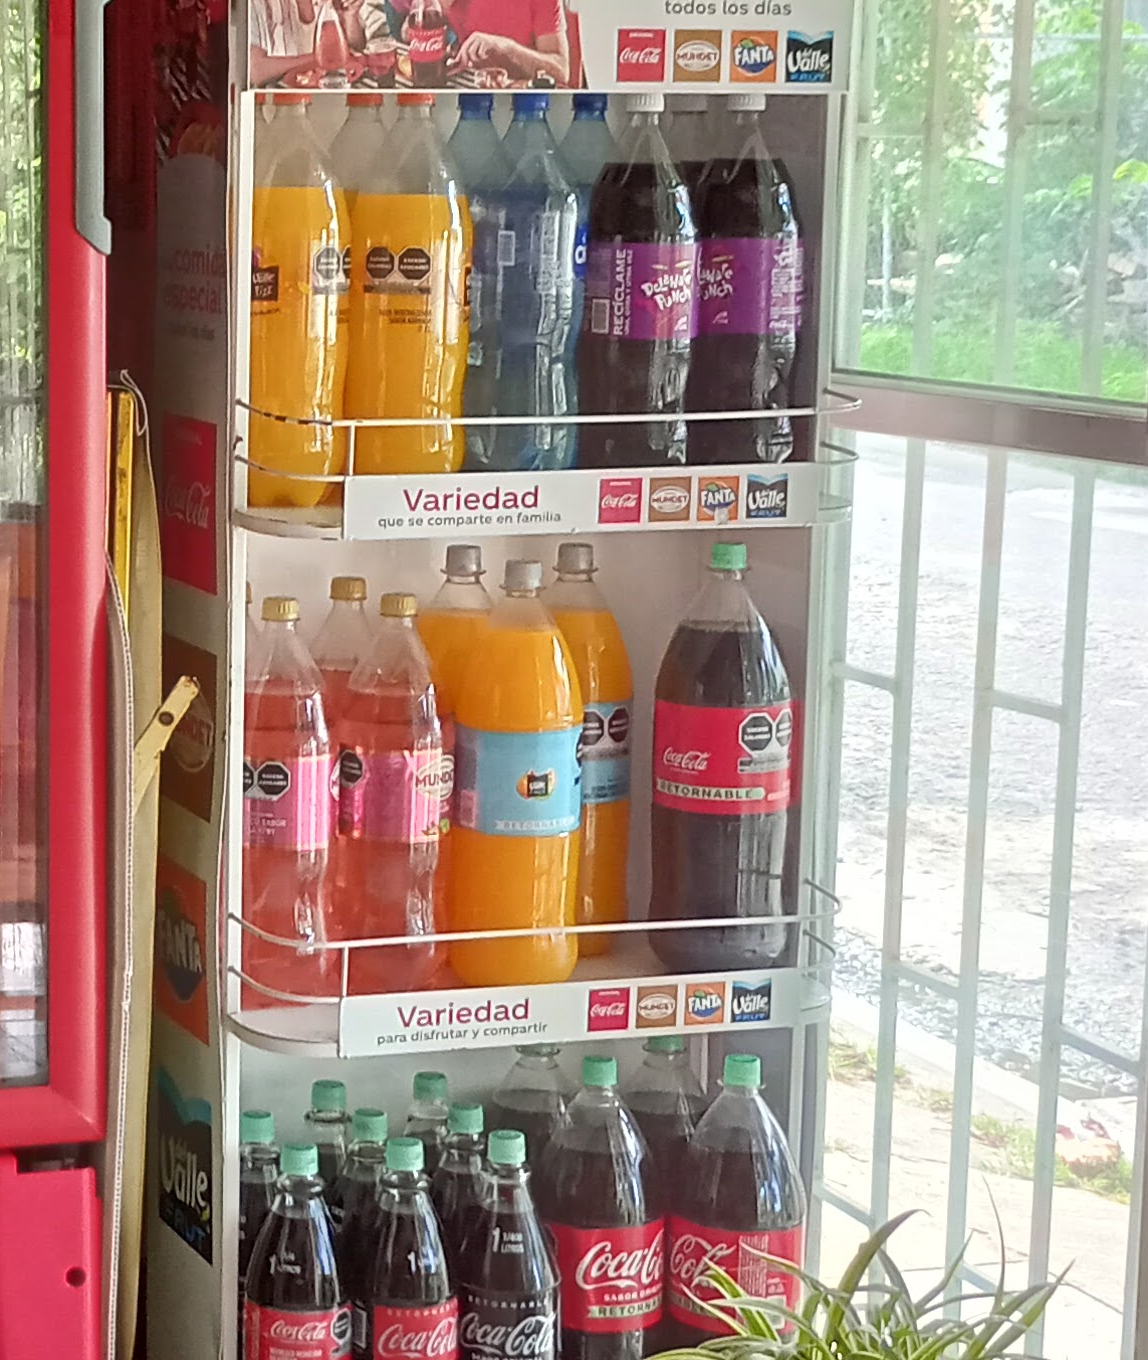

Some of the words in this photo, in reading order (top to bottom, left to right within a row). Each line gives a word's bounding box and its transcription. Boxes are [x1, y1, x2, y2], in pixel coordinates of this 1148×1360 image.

[664, 0, 717, 16] todos
[722, 0, 749, 16] los
[754, 0, 793, 16] días
[733, 43, 775, 66] FANTA
[786, 50, 831, 72] Valle
[403, 484, 540, 512] Variedad
[701, 489, 736, 507] FANTA
[747, 490, 786, 510] Valle
[377, 516, 404, 530] que
[408, 516, 424, 527] se
[427, 512, 492, 528] comparte
[496, 514, 513, 524] en
[516, 510, 562, 524] familia
[662, 746, 712, 771] Coca-Cola
[414, 769, 454, 789] MUND
[659, 779, 753, 800] RETORNABLE
[396, 996, 530, 1028] Variedad
[687, 991, 722, 1014] FANTA
[732, 994, 769, 1015] Valle
[376, 1034, 408, 1046] para
[410, 1027, 469, 1042] disfrutar
[471, 1027, 481, 1040] y
[483, 1021, 549, 1037] compartir
[575, 1228, 664, 1290] Coca-Co
[603, 1292, 638, 1302] SABOR
[376, 1316, 457, 1359] Coca-Col
[460, 1312, 557, 1356] Coca-Cola
